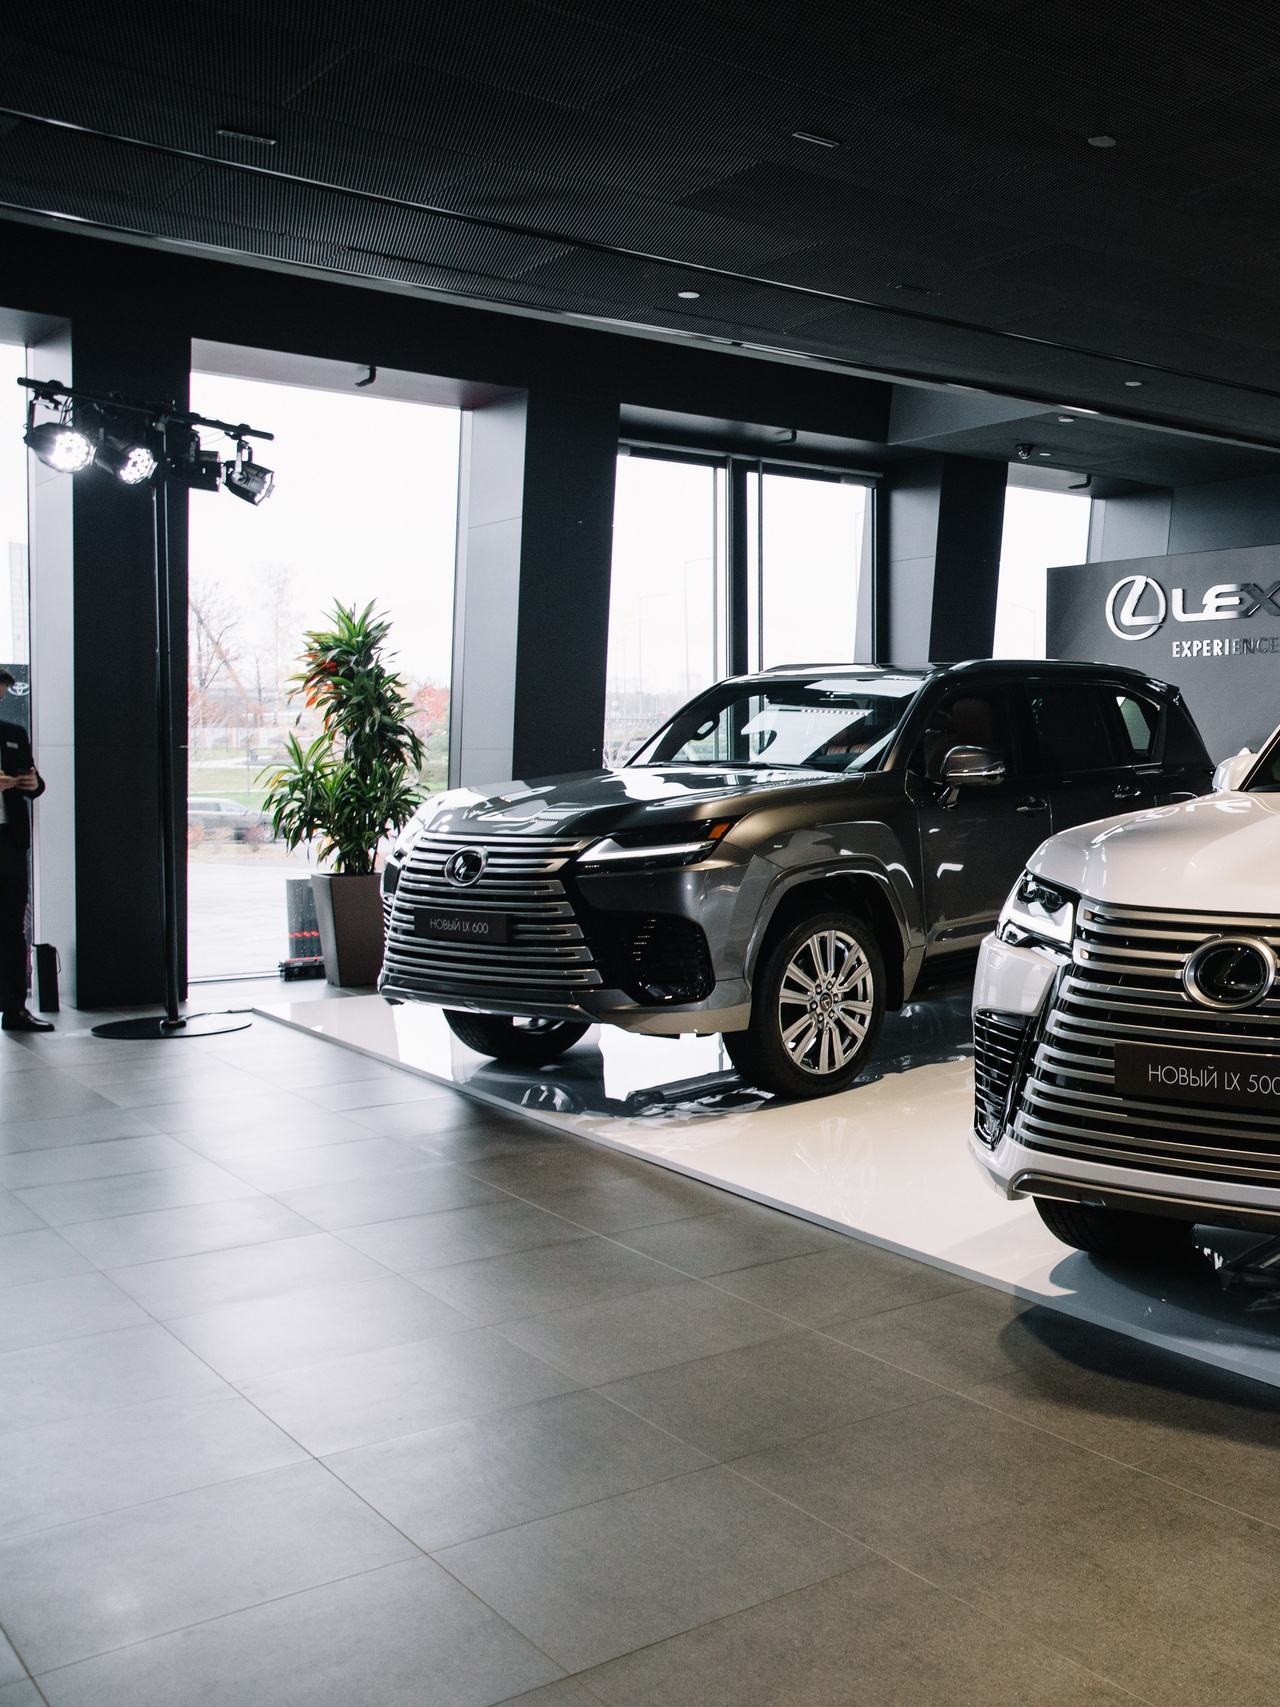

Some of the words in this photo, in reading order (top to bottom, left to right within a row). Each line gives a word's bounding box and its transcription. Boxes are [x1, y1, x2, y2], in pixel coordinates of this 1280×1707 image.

[1172, 636, 1280, 658] EXPERIENCE
[429, 917, 461, 931] НОВЫЙ
[471, 922, 489, 934] 600
[1148, 1064, 1218, 1088] НОВЫЙ
[1224, 1071, 1241, 1091] LX
